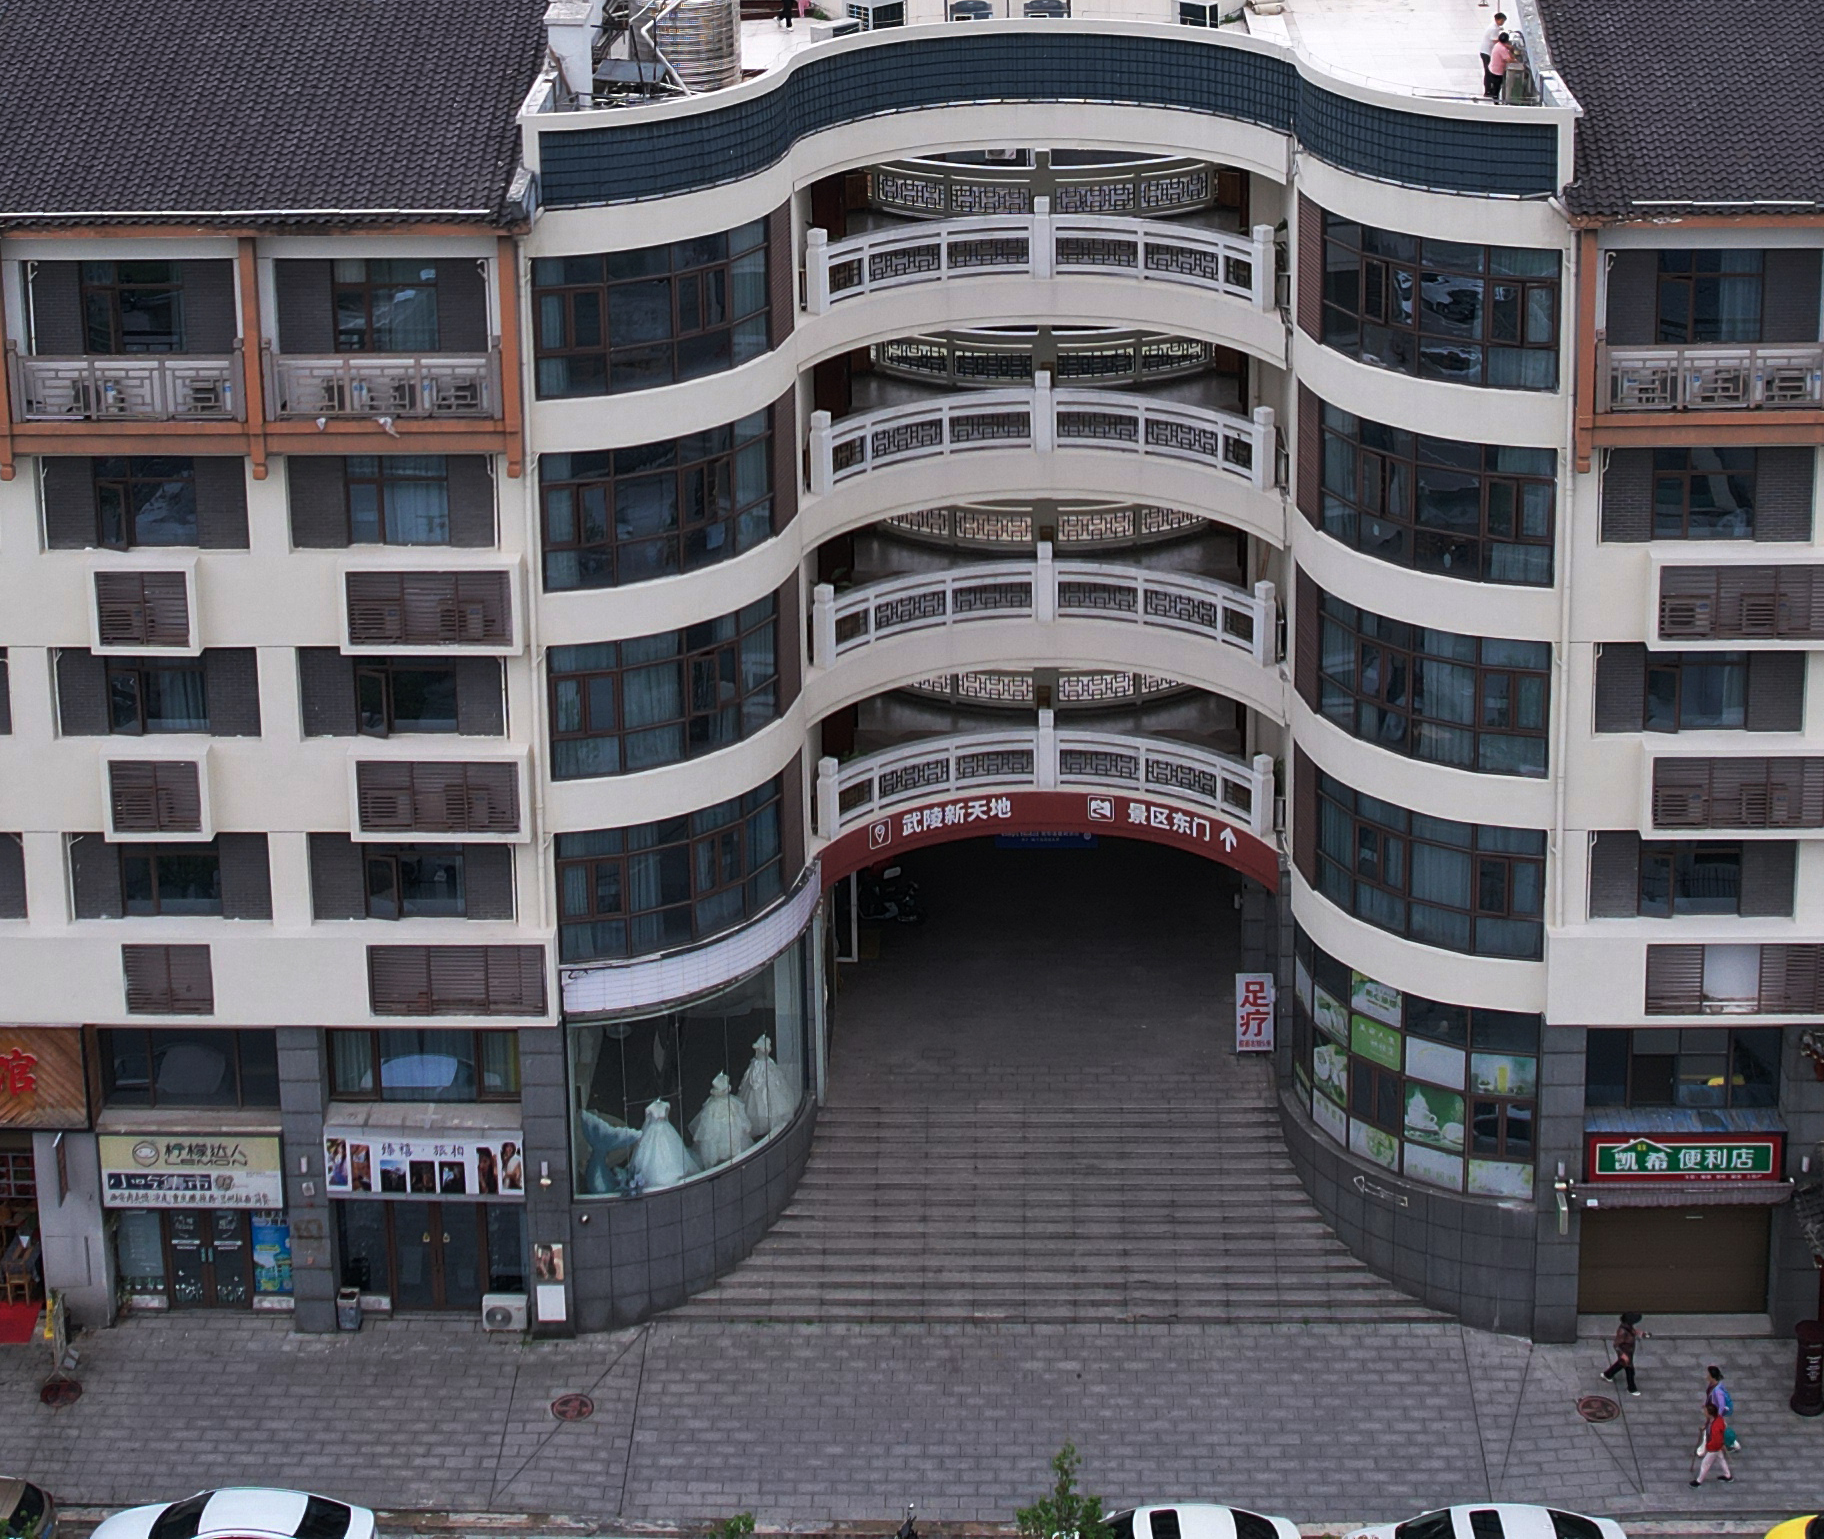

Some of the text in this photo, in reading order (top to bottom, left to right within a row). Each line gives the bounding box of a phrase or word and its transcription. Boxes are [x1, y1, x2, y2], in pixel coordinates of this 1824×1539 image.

[902, 797, 1012, 836] 武陵新天地
[1127, 803, 1211, 842] 景区东门
[1239, 981, 1271, 1038] 足疗
[164, 1142, 247, 1158] 柠檬达人
